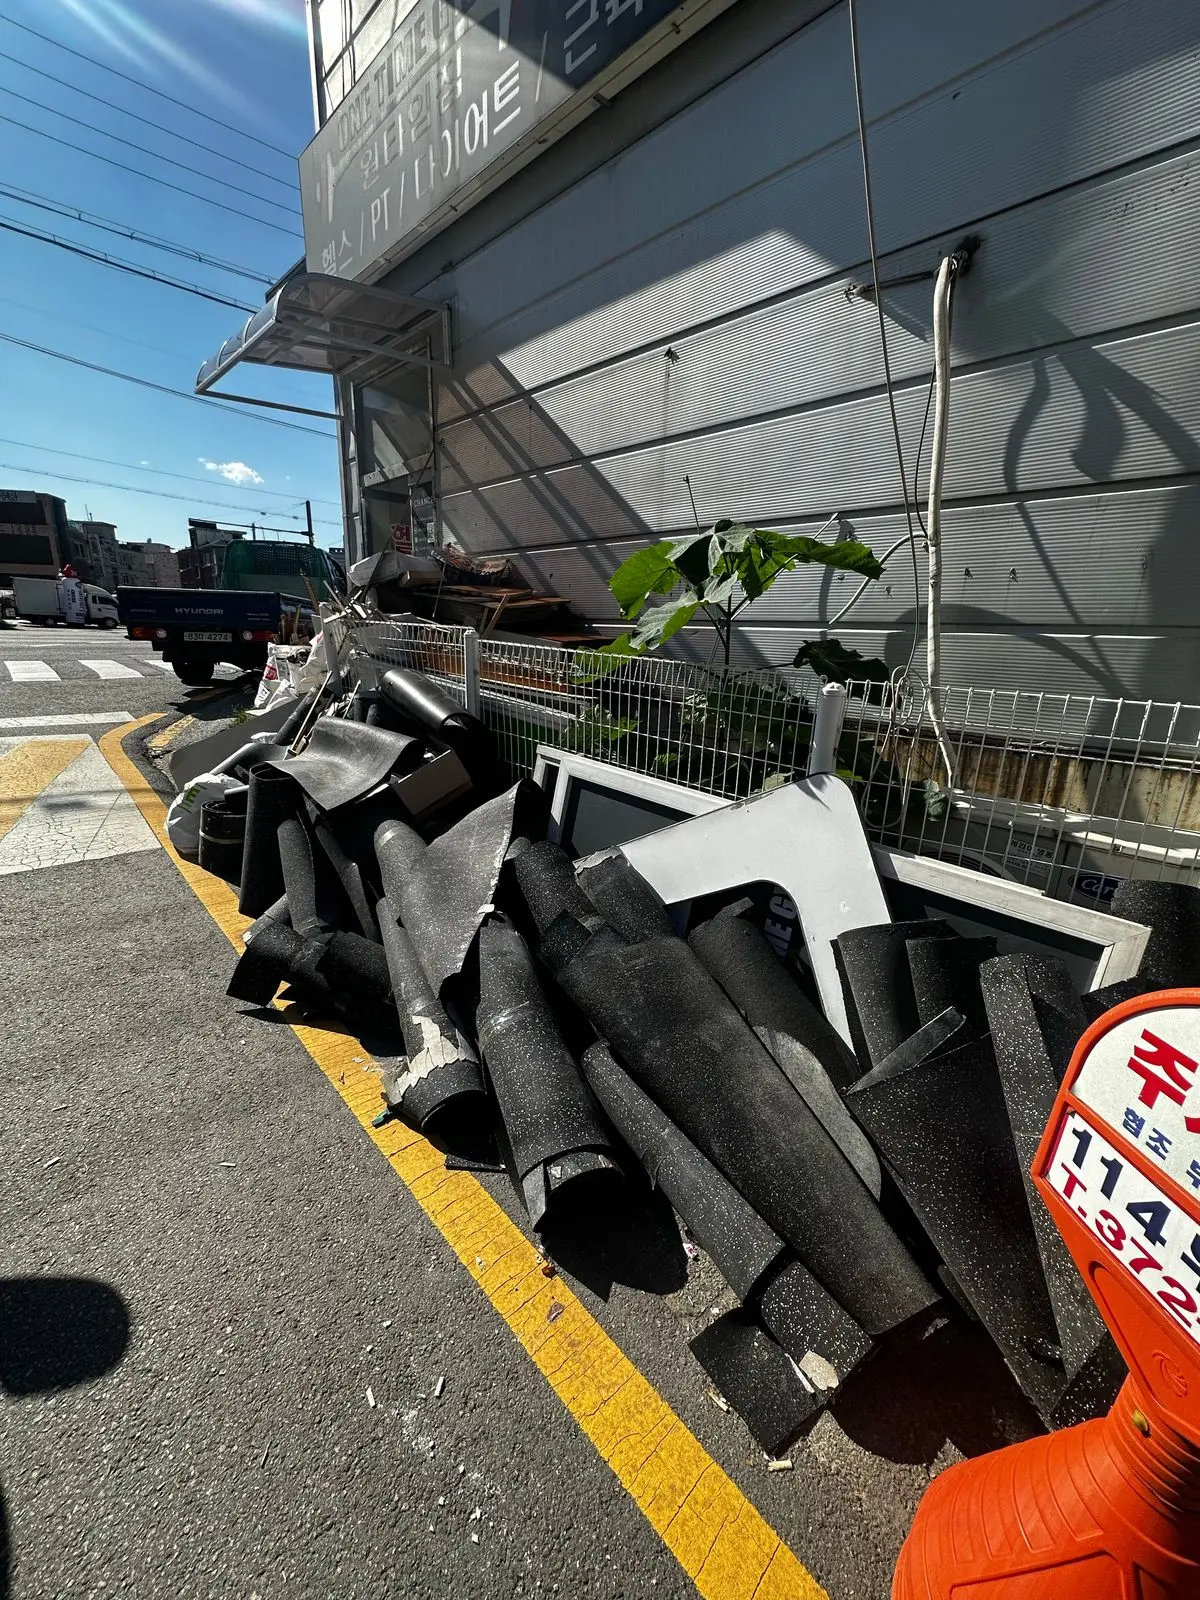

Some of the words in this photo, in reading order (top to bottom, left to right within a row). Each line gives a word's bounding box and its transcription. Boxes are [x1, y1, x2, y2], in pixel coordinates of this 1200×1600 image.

[373, 12, 428, 108] TIME
[322, 229, 353, 276] 헬스
[371, 187, 391, 242] PT
[414, 60, 522, 200] 다이어트
[174, 607, 224, 615] HYUNDAI
[1122, 1106, 1173, 1161] 협조
[1060, 1162, 1200, 1330] T.372
